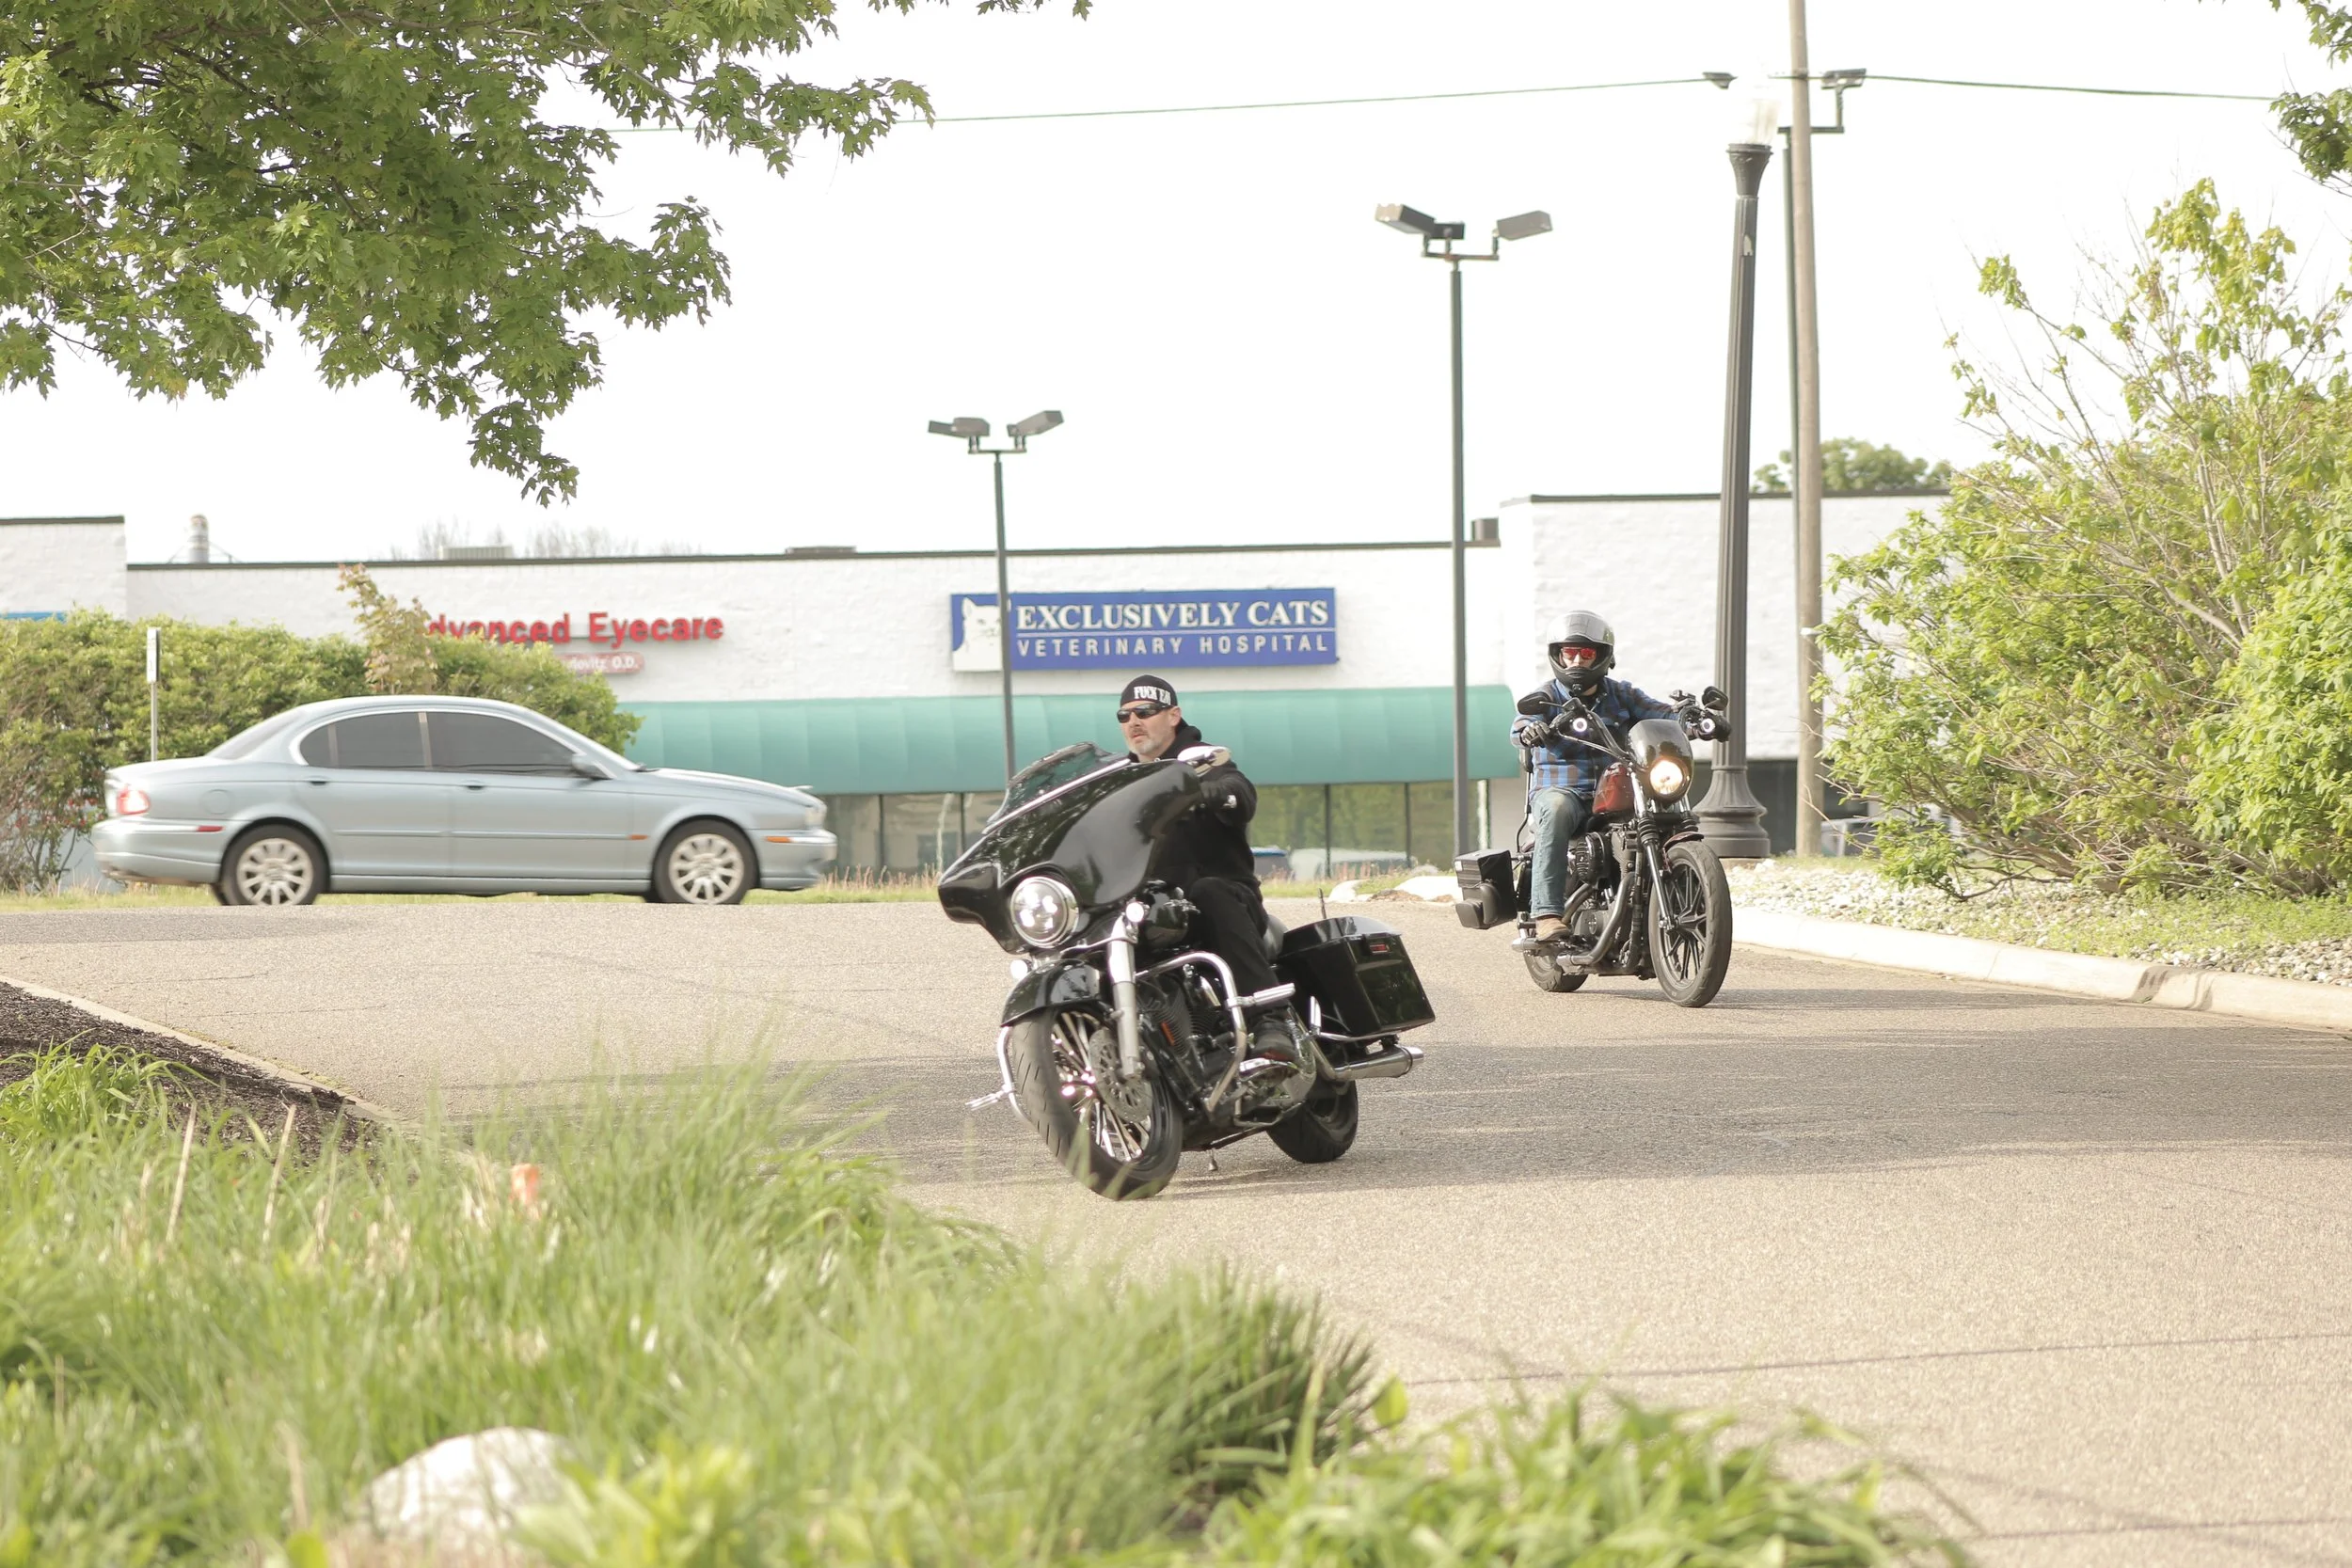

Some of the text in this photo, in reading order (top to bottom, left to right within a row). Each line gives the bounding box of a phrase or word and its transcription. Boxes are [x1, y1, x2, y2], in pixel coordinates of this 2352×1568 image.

[428, 611, 723, 649] dvanced Eyecare
[1016, 599, 1328, 630] EXCLUSIVELY CATS
[1017, 634, 1328, 657] VETERINARY HOSPITAL
